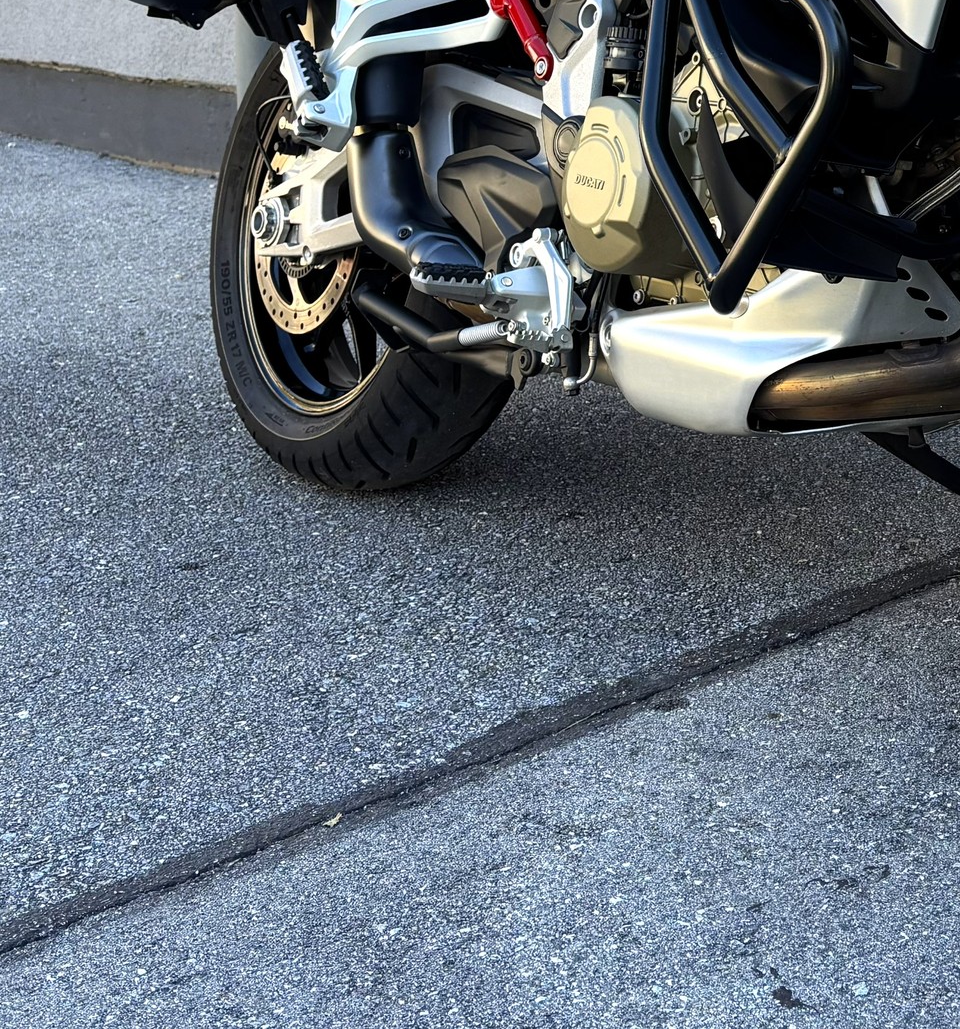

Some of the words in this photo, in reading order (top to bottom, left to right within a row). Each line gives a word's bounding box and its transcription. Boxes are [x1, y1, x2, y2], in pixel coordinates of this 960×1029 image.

[574, 173, 606, 191] DUCATI
[220, 259, 234, 317] 190/55
[225, 321, 238, 344] ZR
[230, 343, 243, 359] 17
